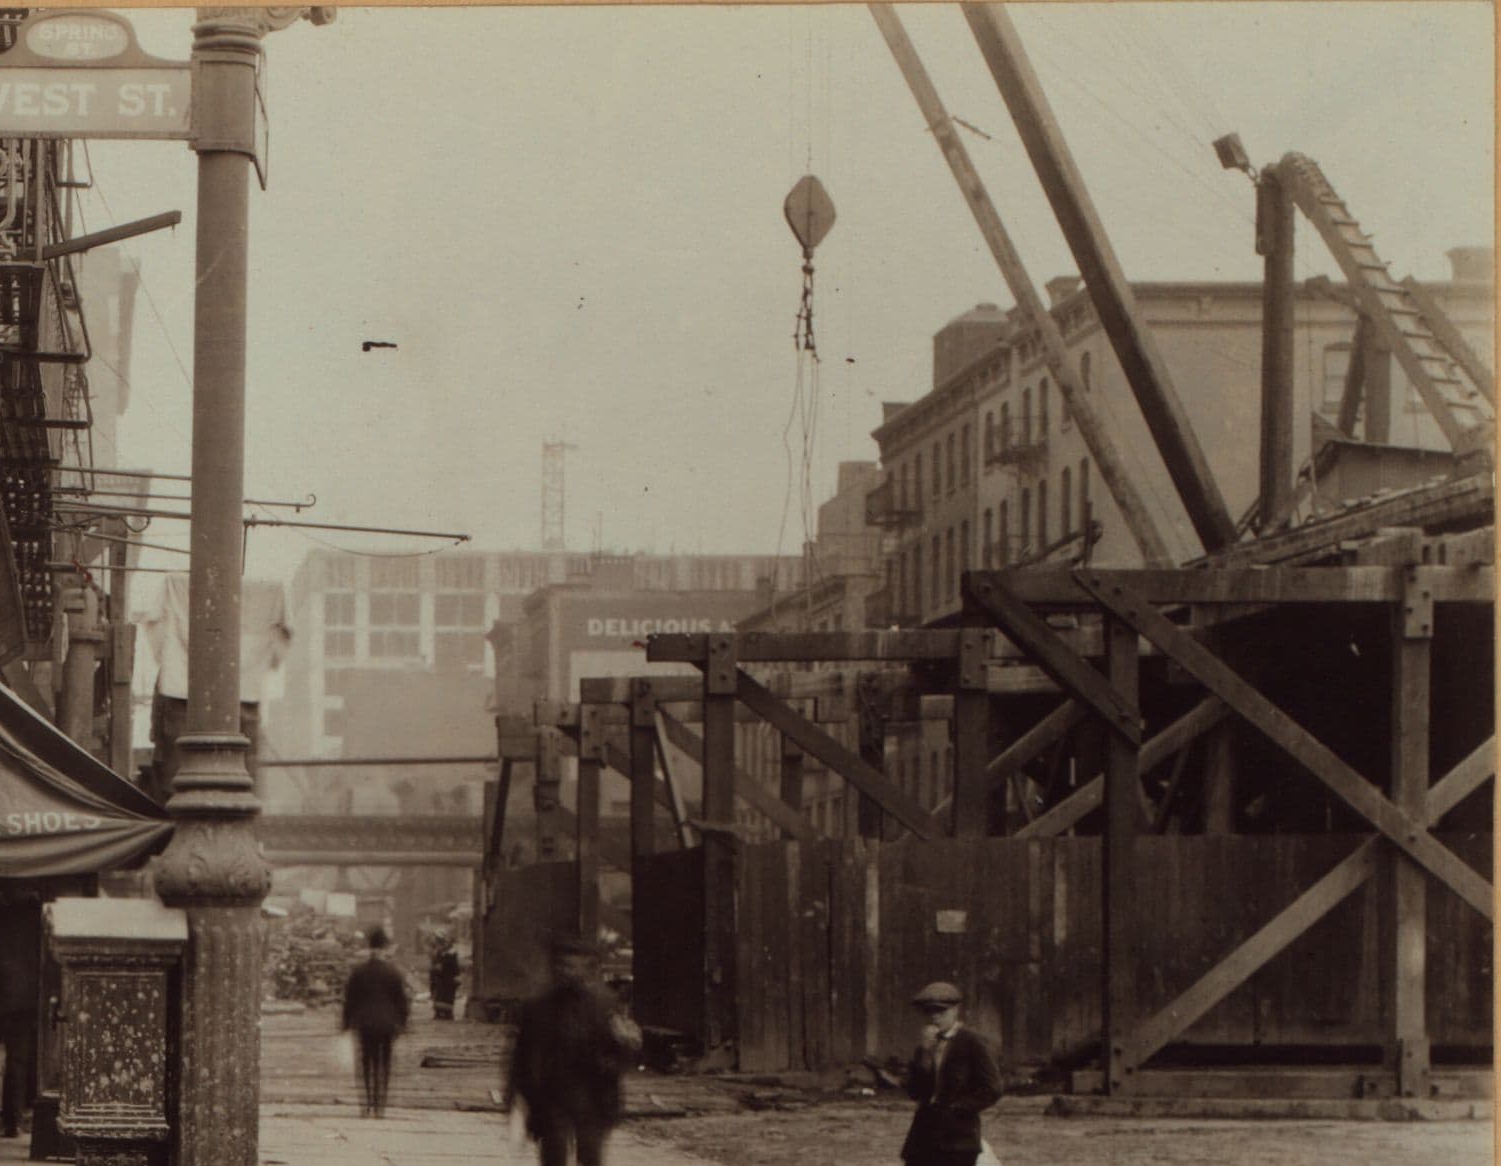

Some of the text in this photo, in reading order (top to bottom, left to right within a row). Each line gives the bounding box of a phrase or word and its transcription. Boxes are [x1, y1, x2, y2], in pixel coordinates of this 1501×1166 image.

[39, 23, 117, 42] SPRING
[117, 82, 178, 117] ST.
[587, 618, 711, 637] DELICIOUS
[7, 811, 101, 835] SHOES
